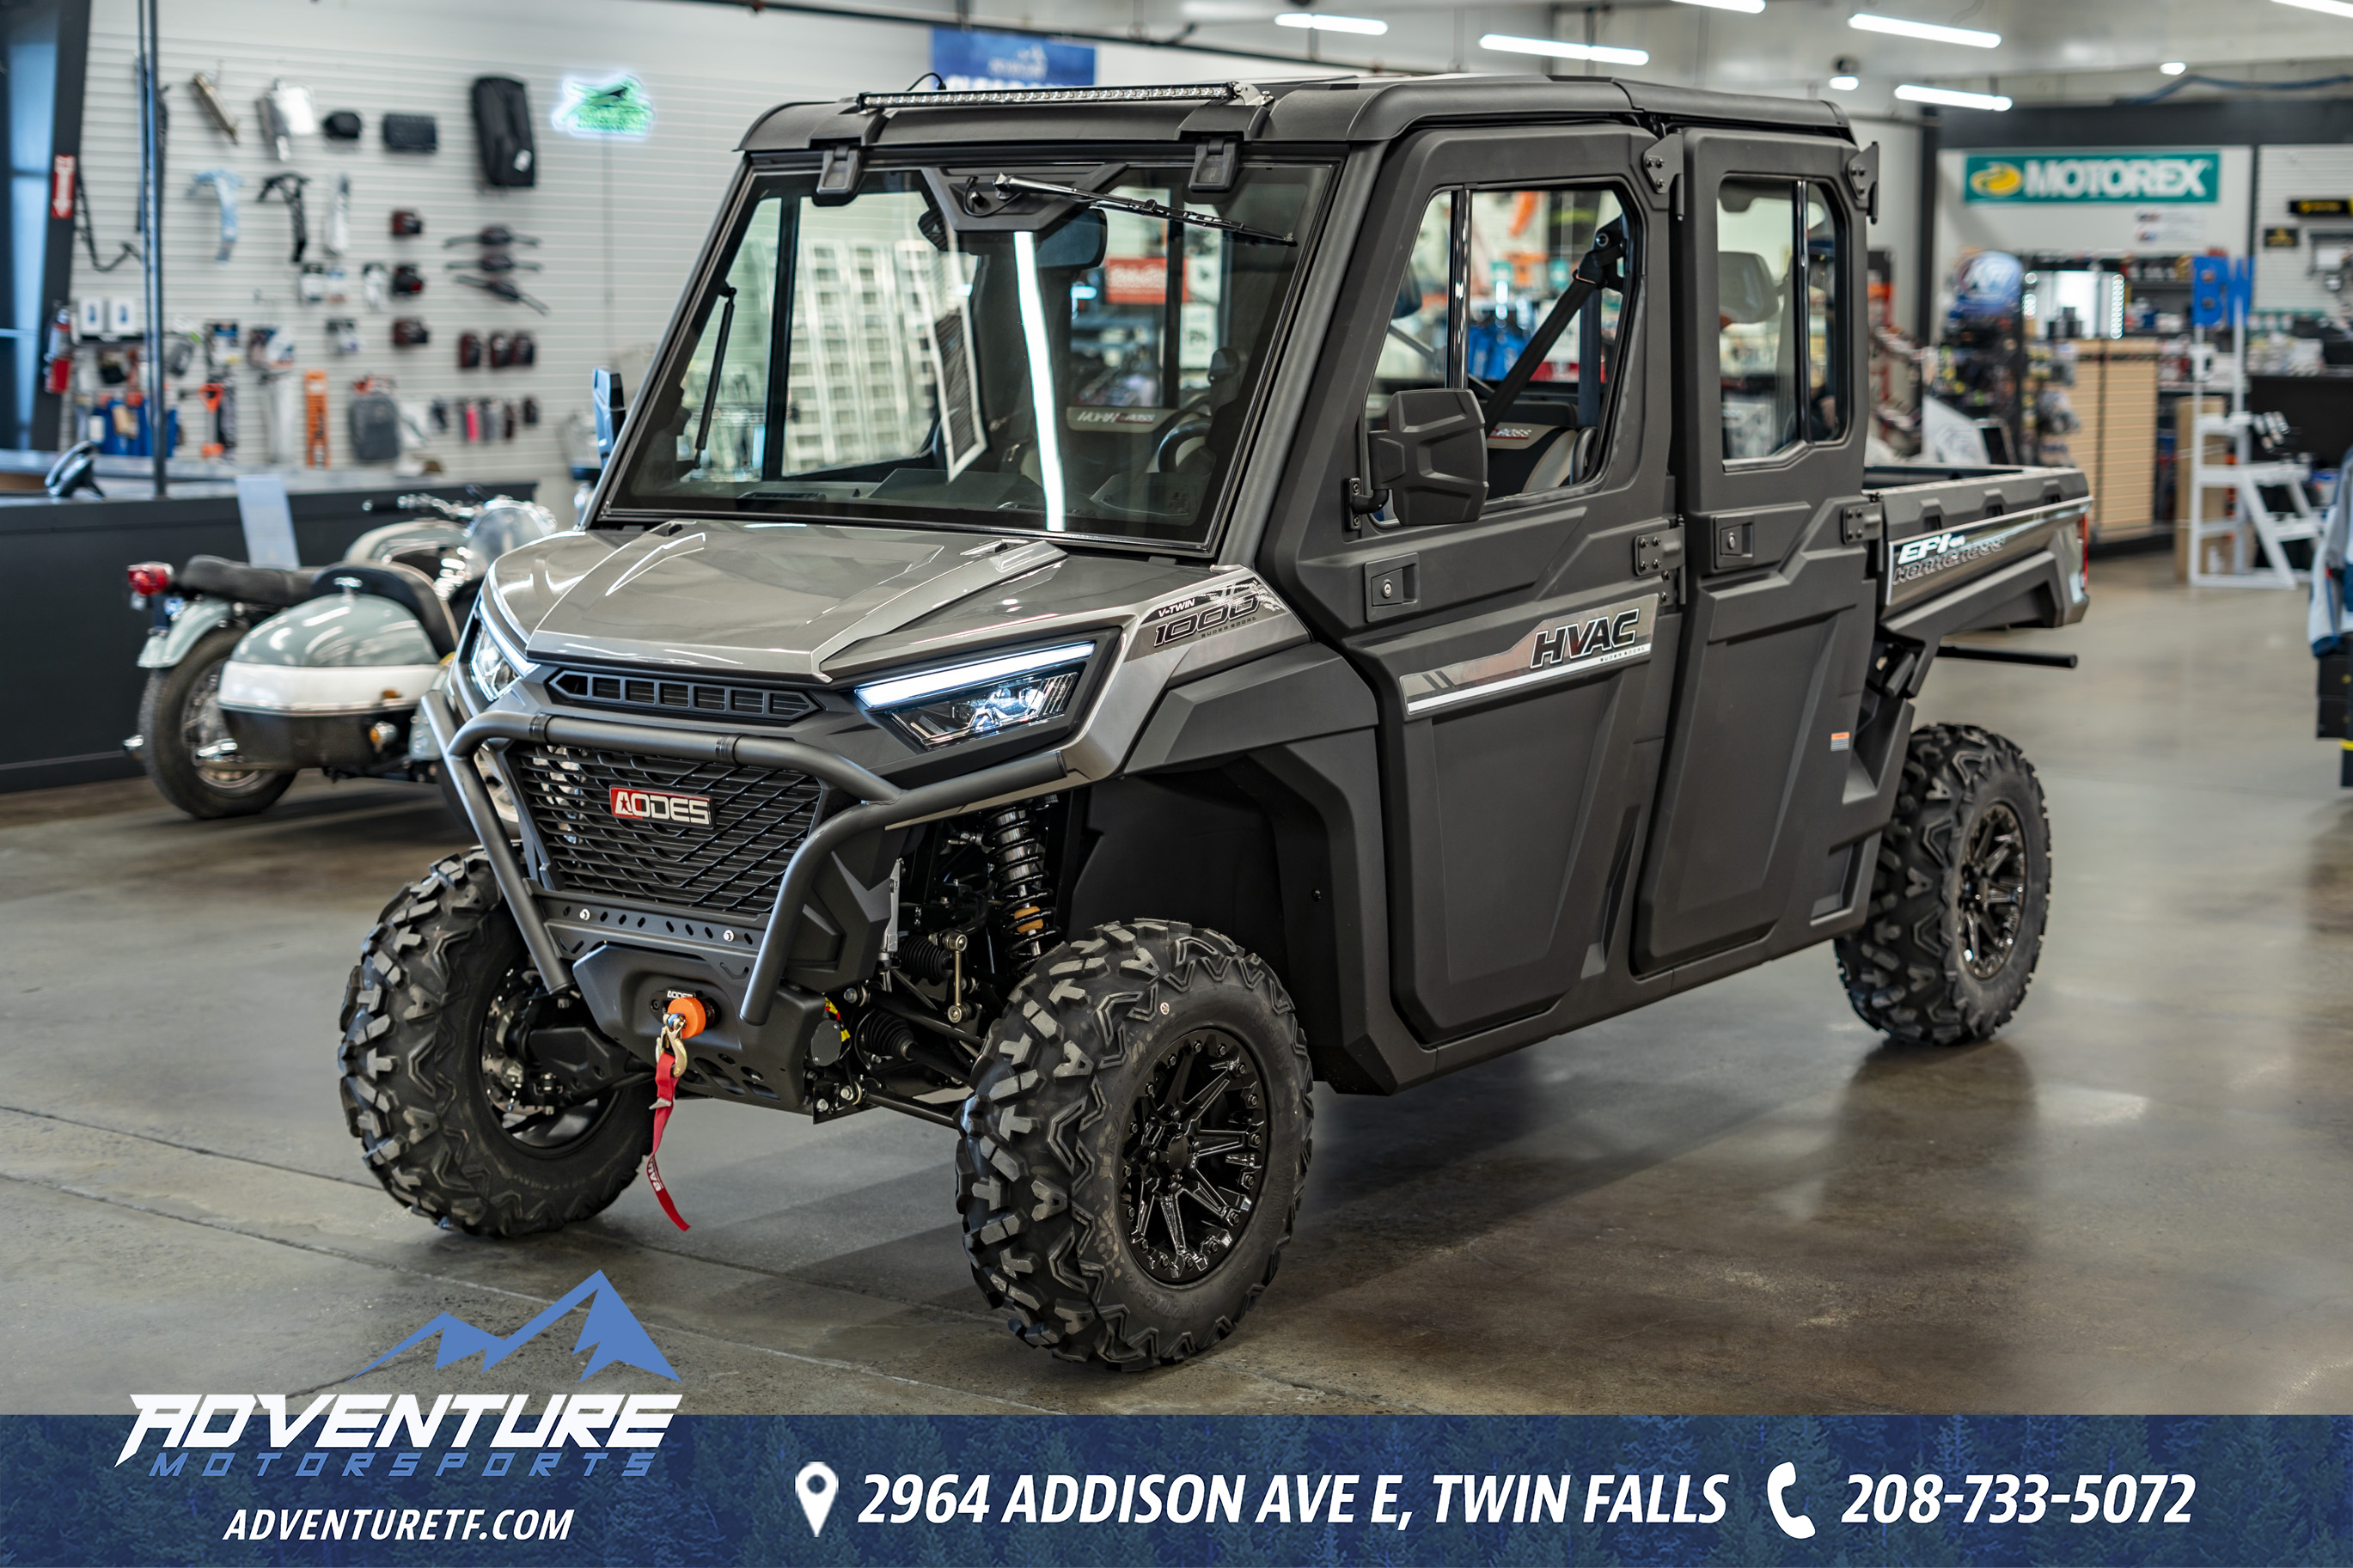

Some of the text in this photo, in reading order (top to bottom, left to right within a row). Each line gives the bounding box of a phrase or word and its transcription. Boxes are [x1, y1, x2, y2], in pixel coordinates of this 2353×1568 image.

[2024, 158, 2210, 198] MOTOREX
[1153, 593, 1261, 647] 1000
[1158, 598, 1195, 618] V-TWIN
[1530, 608, 1640, 668] HVAC
[614, 791, 710, 825] AODES
